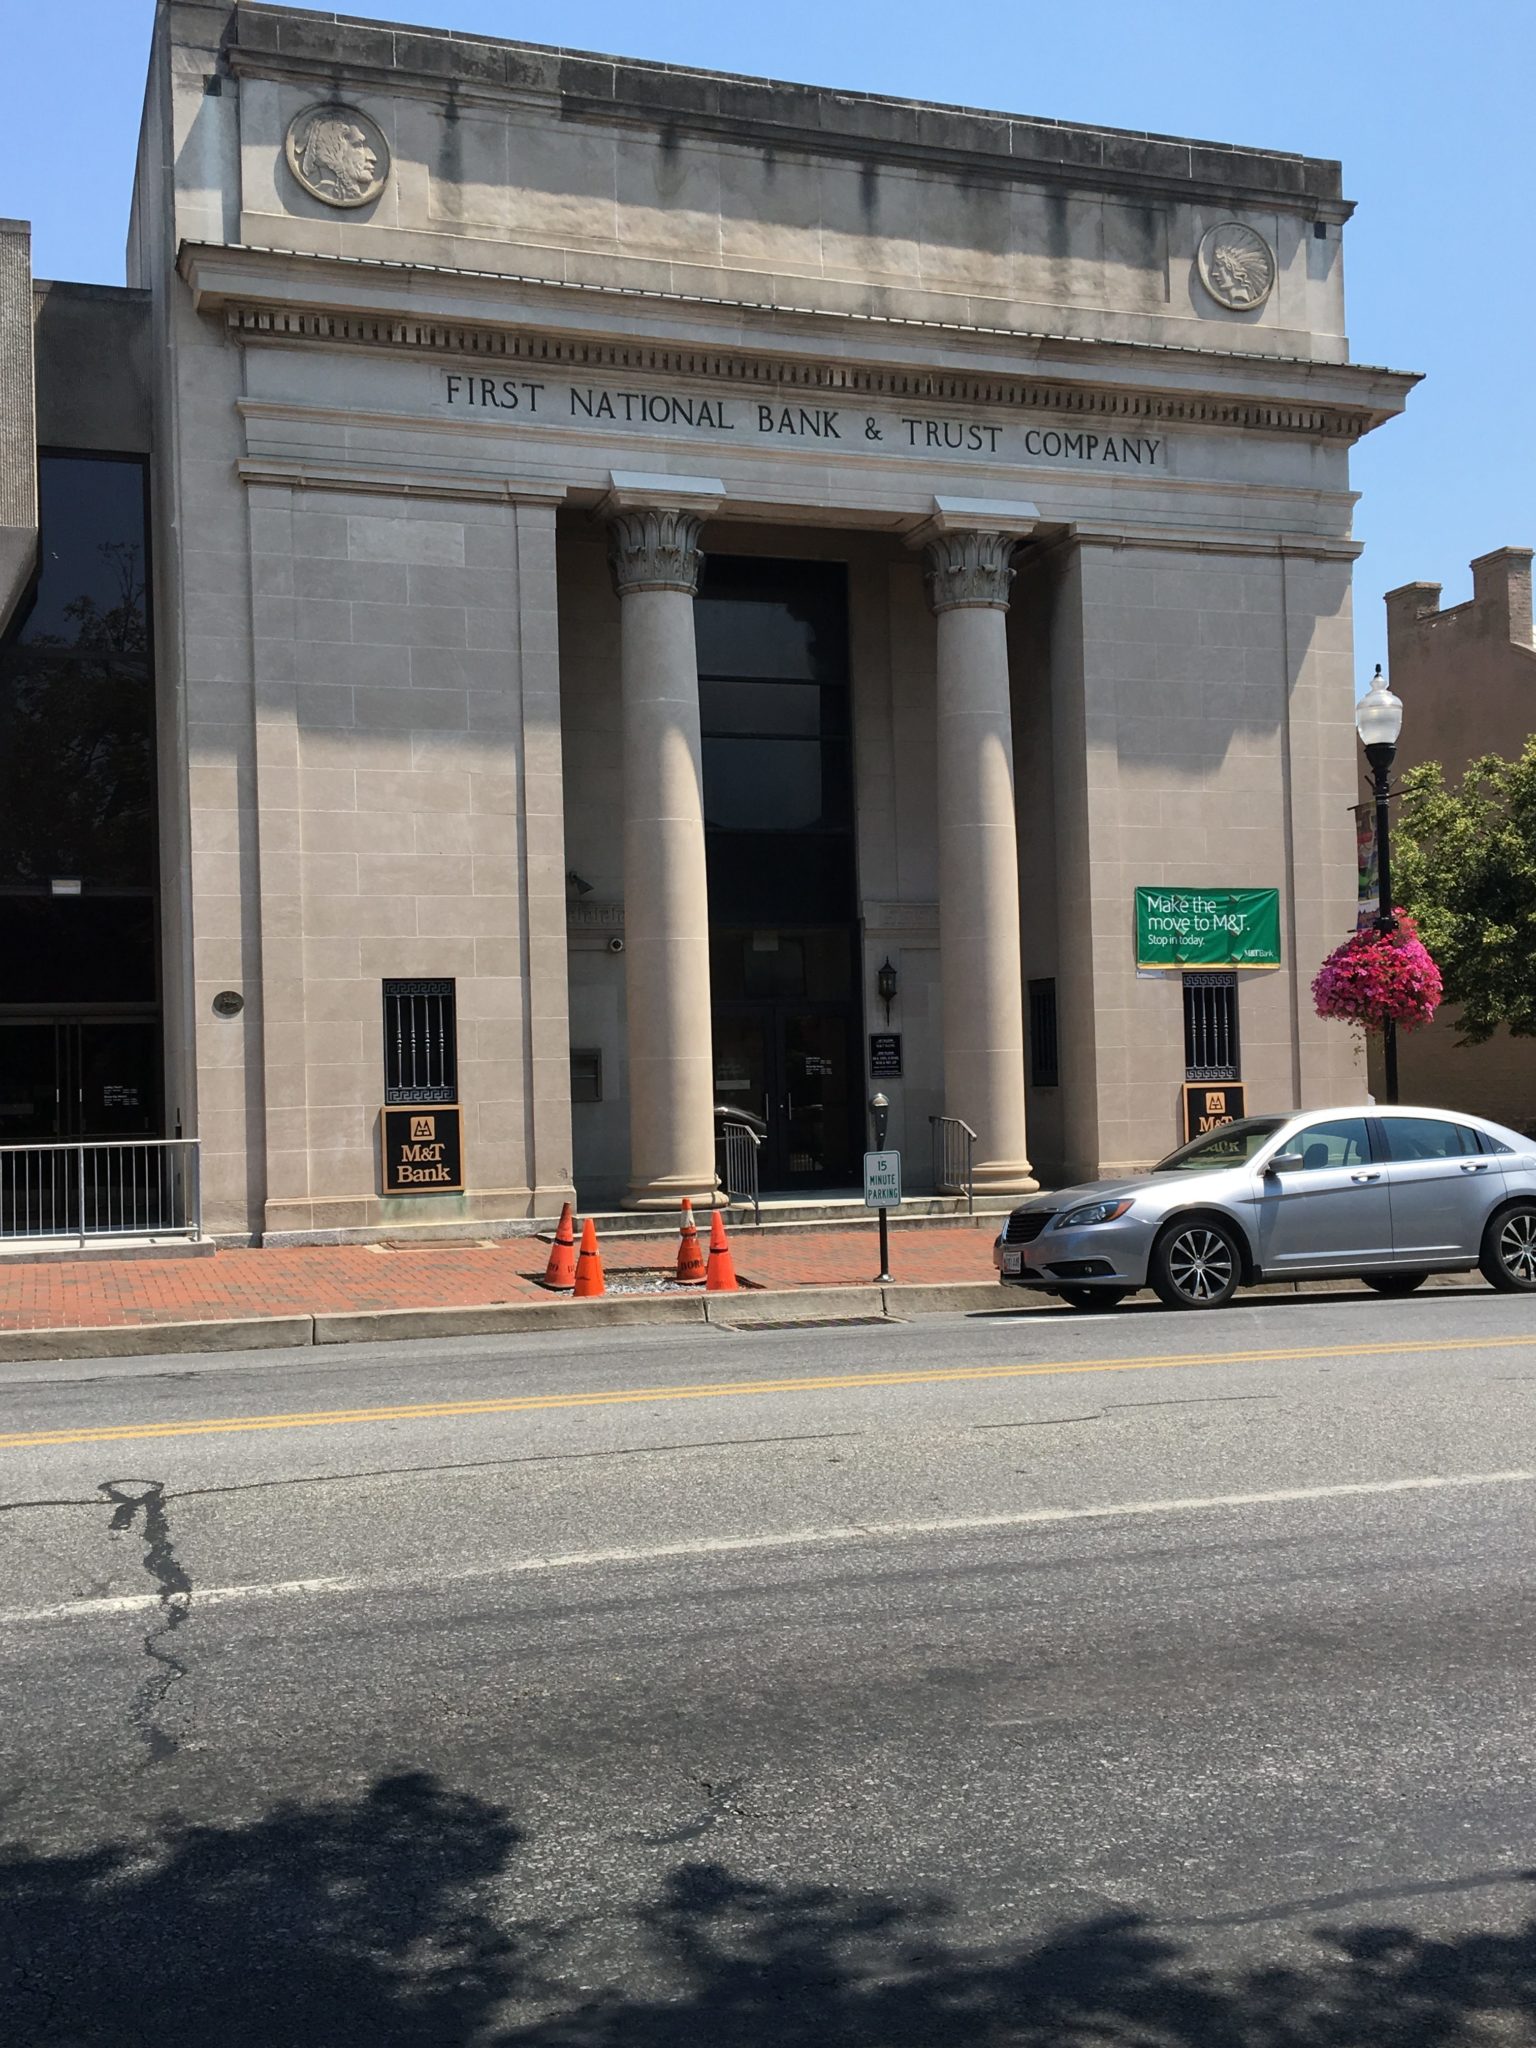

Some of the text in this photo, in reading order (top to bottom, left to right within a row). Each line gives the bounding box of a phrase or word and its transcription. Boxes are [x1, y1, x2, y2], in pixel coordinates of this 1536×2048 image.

[446, 375, 1161, 465] FIRST NATIONAL BANK & TRUST COMPANY
[1147, 895, 1217, 914] Make the
[1148, 914, 1250, 931] move to M&T.
[1148, 934, 1206, 948] Stop in today.
[401, 1143, 446, 1162] M&T
[396, 1162, 452, 1183] Bank
[877, 1160, 887, 1171] 15
[869, 1174, 896, 1186] MINUTE
[867, 1188, 898, 1200] PARKING
